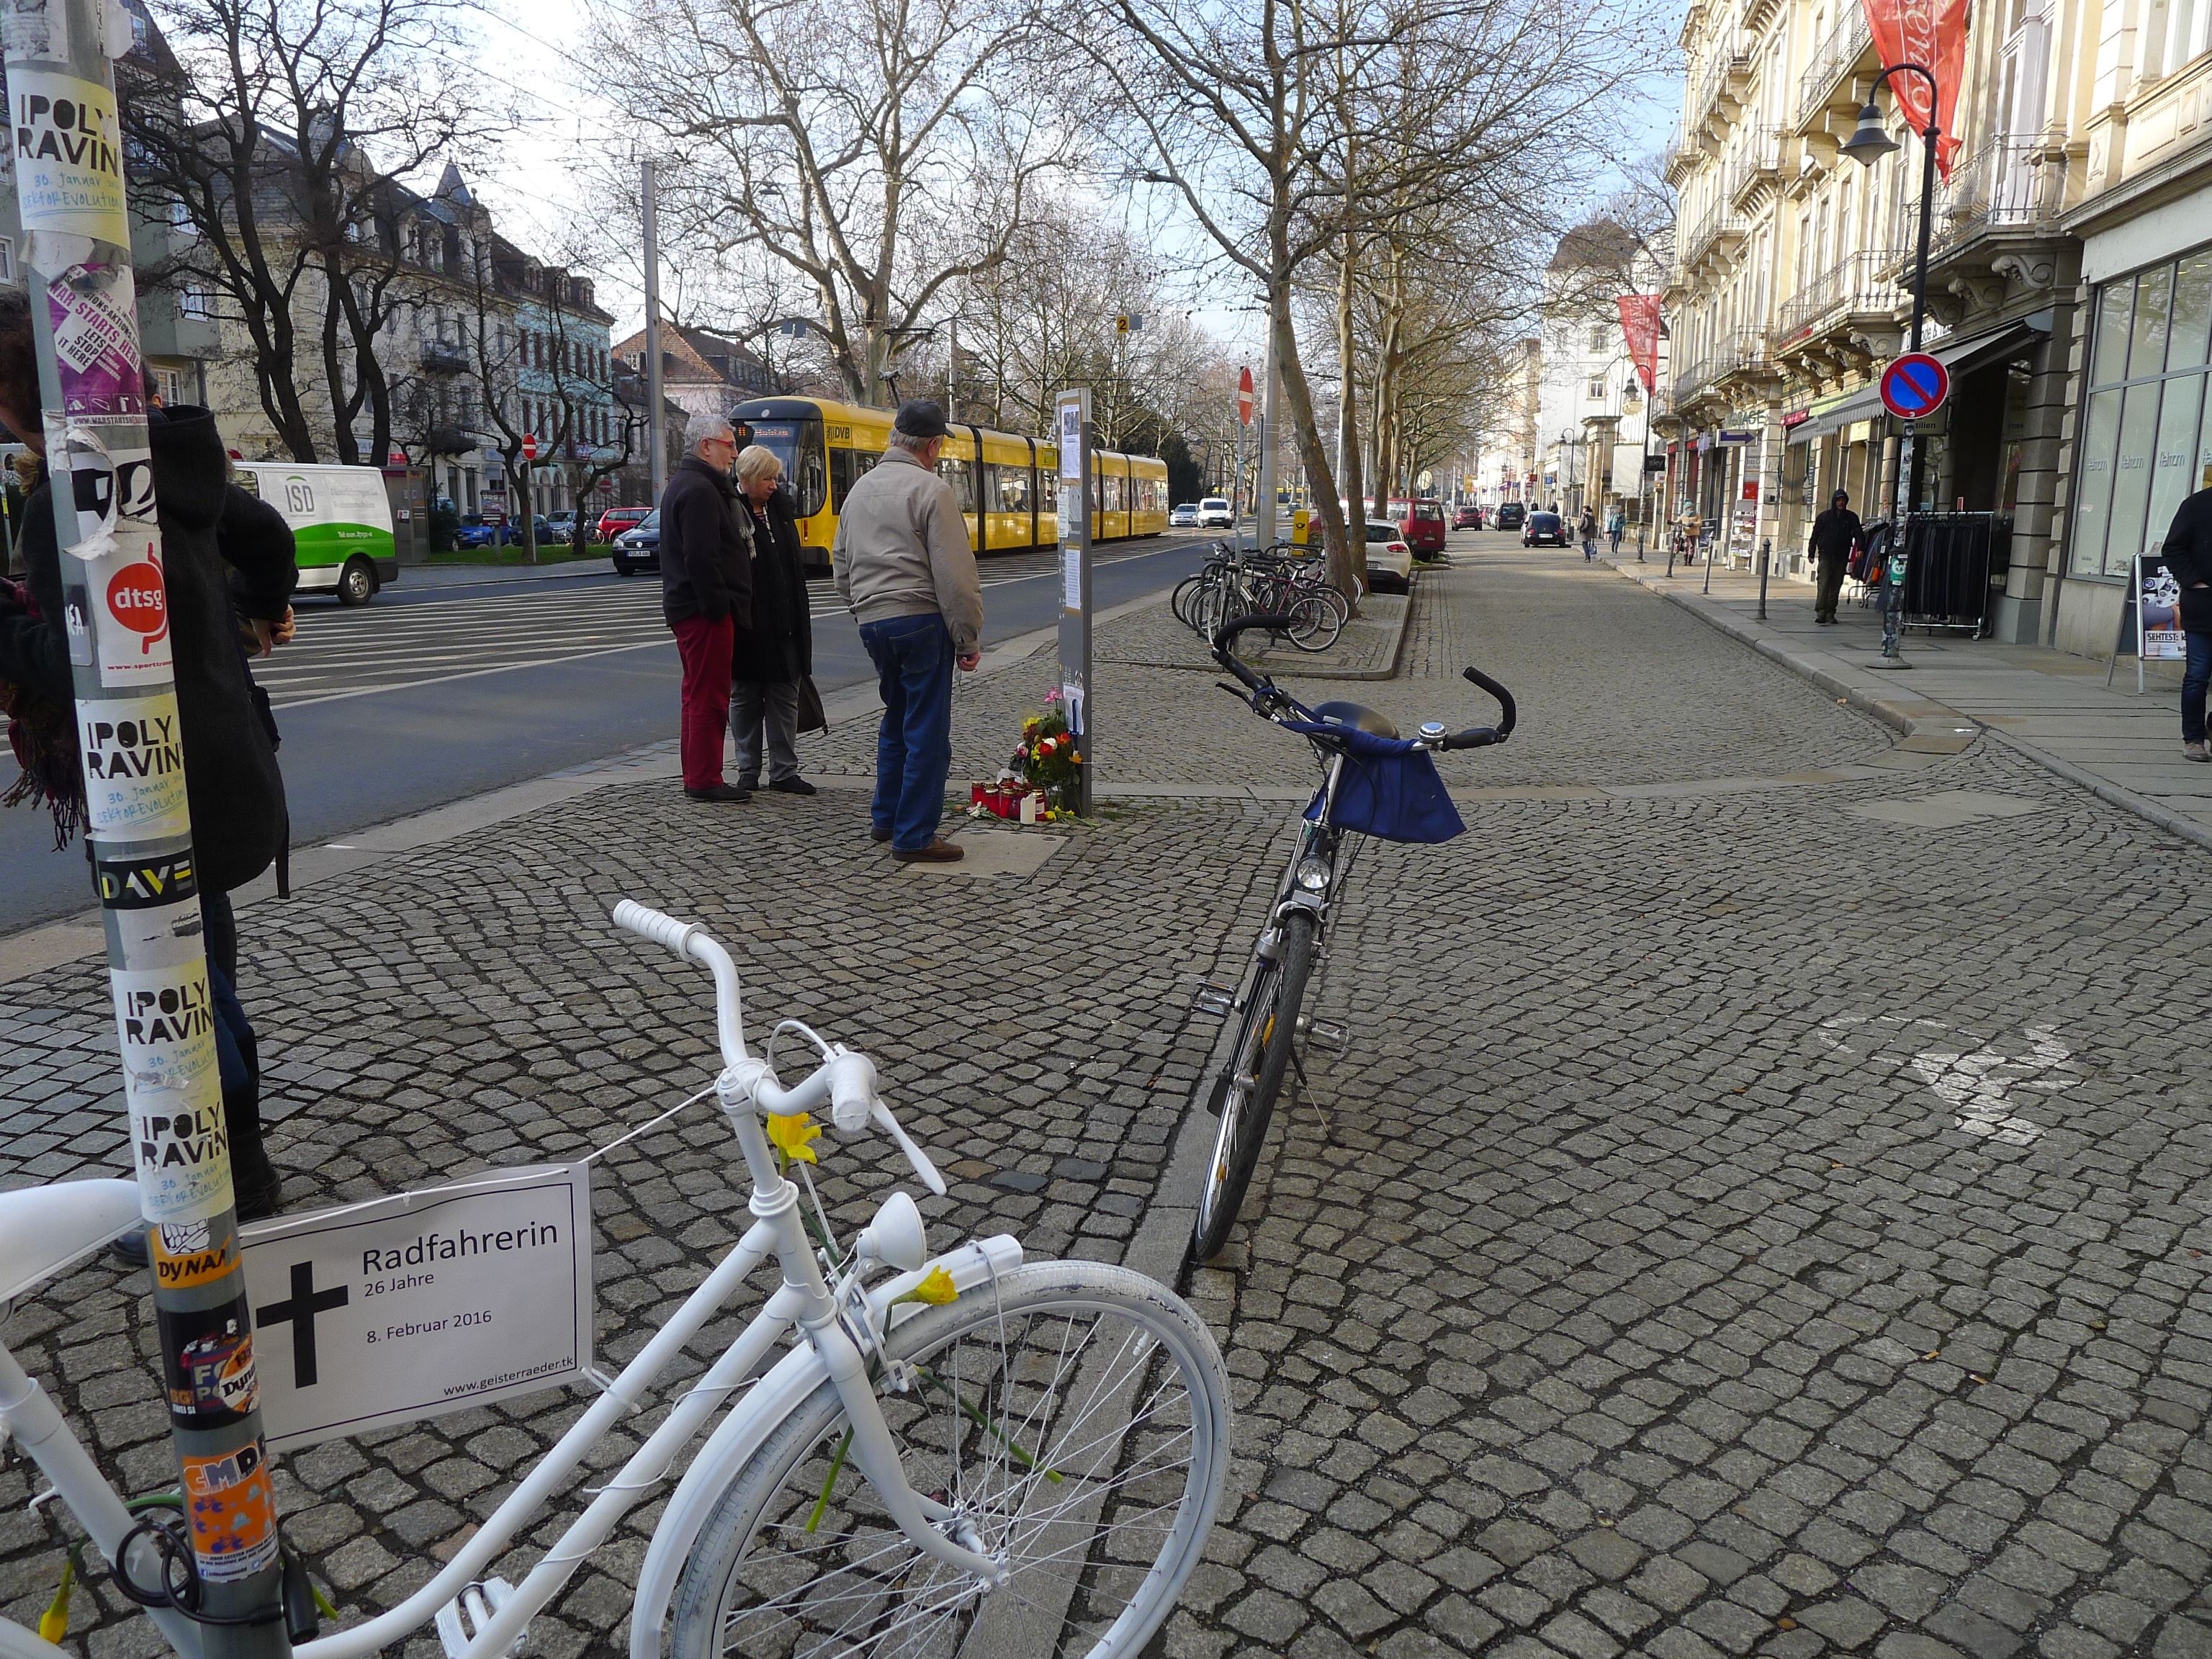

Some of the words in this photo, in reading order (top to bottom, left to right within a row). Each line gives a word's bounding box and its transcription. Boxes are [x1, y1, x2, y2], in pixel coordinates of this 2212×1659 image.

[75, 302, 120, 343] STARTS
[118, 338, 140, 372] HERE
[1118, 319, 1126, 330] 2
[74, 336, 99, 356] STOP
[84, 328, 106, 349] LETS
[67, 345, 91, 367] HERE
[835, 426, 850, 439] DVB
[1648, 459, 1663, 468] sky
[284, 485, 315, 512] ISD
[115, 588, 163, 610] dtsg
[87, 715, 172, 750] IPOLY
[101, 860, 194, 899] DAVE
[127, 977, 206, 1017] IPOLY
[143, 1101, 220, 1141] IPOLY
[362, 1220, 558, 1275] Radfahrerin
[364, 1280, 385, 1297] 26
[390, 1272, 434, 1292] Jahre
[367, 1330, 382, 1344] 8.
[387, 1317, 449, 1340] Februar
[453, 1310, 492, 1327] 2016
[444, 1357, 574, 1396] www.geisterraeder.tk
